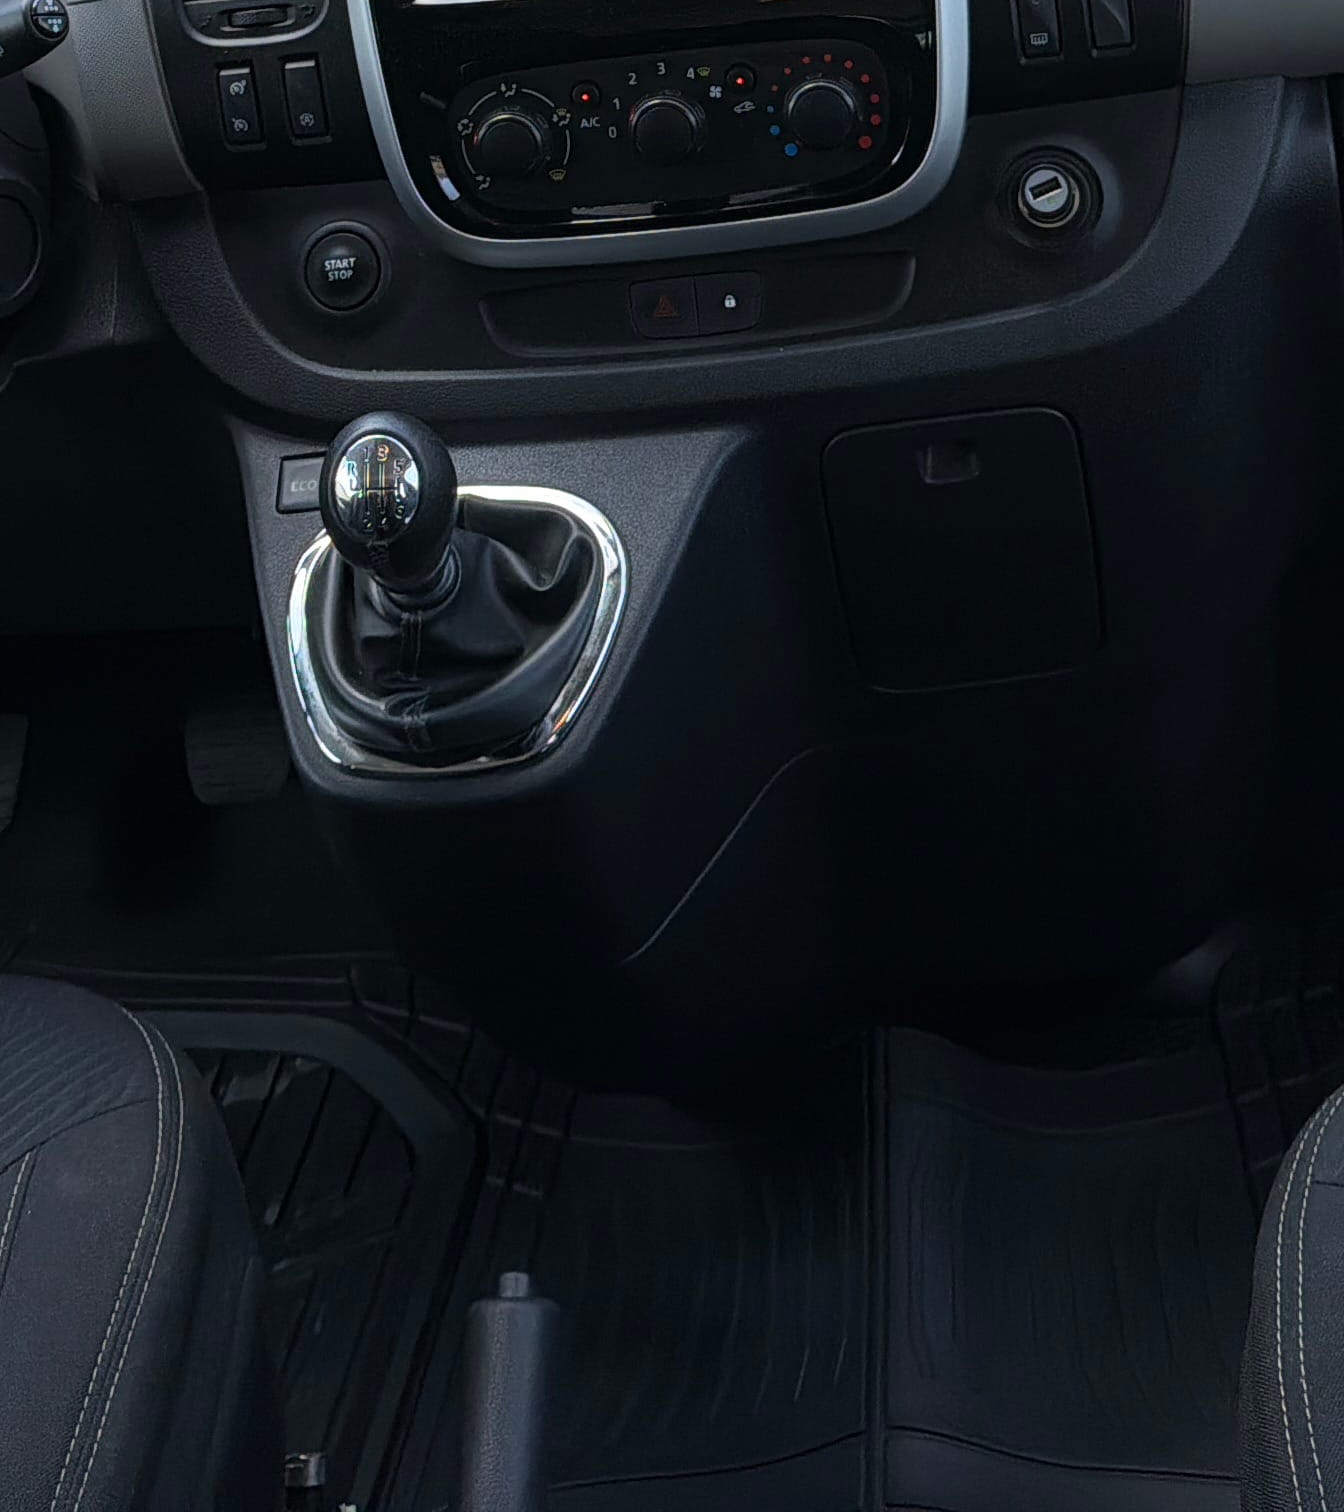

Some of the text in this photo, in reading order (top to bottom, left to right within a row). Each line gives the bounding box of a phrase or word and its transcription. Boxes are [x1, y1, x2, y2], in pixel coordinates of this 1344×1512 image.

[657, 61, 666, 76] 3
[686, 66, 695, 81] 4
[628, 72, 638, 86] 2
[612, 96, 621, 111] 1
[579, 115, 601, 130] A/C
[608, 126, 618, 139] 0
[324, 257, 357, 272] START
[327, 268, 354, 282] STOP
[393, 459, 404, 476] 5
